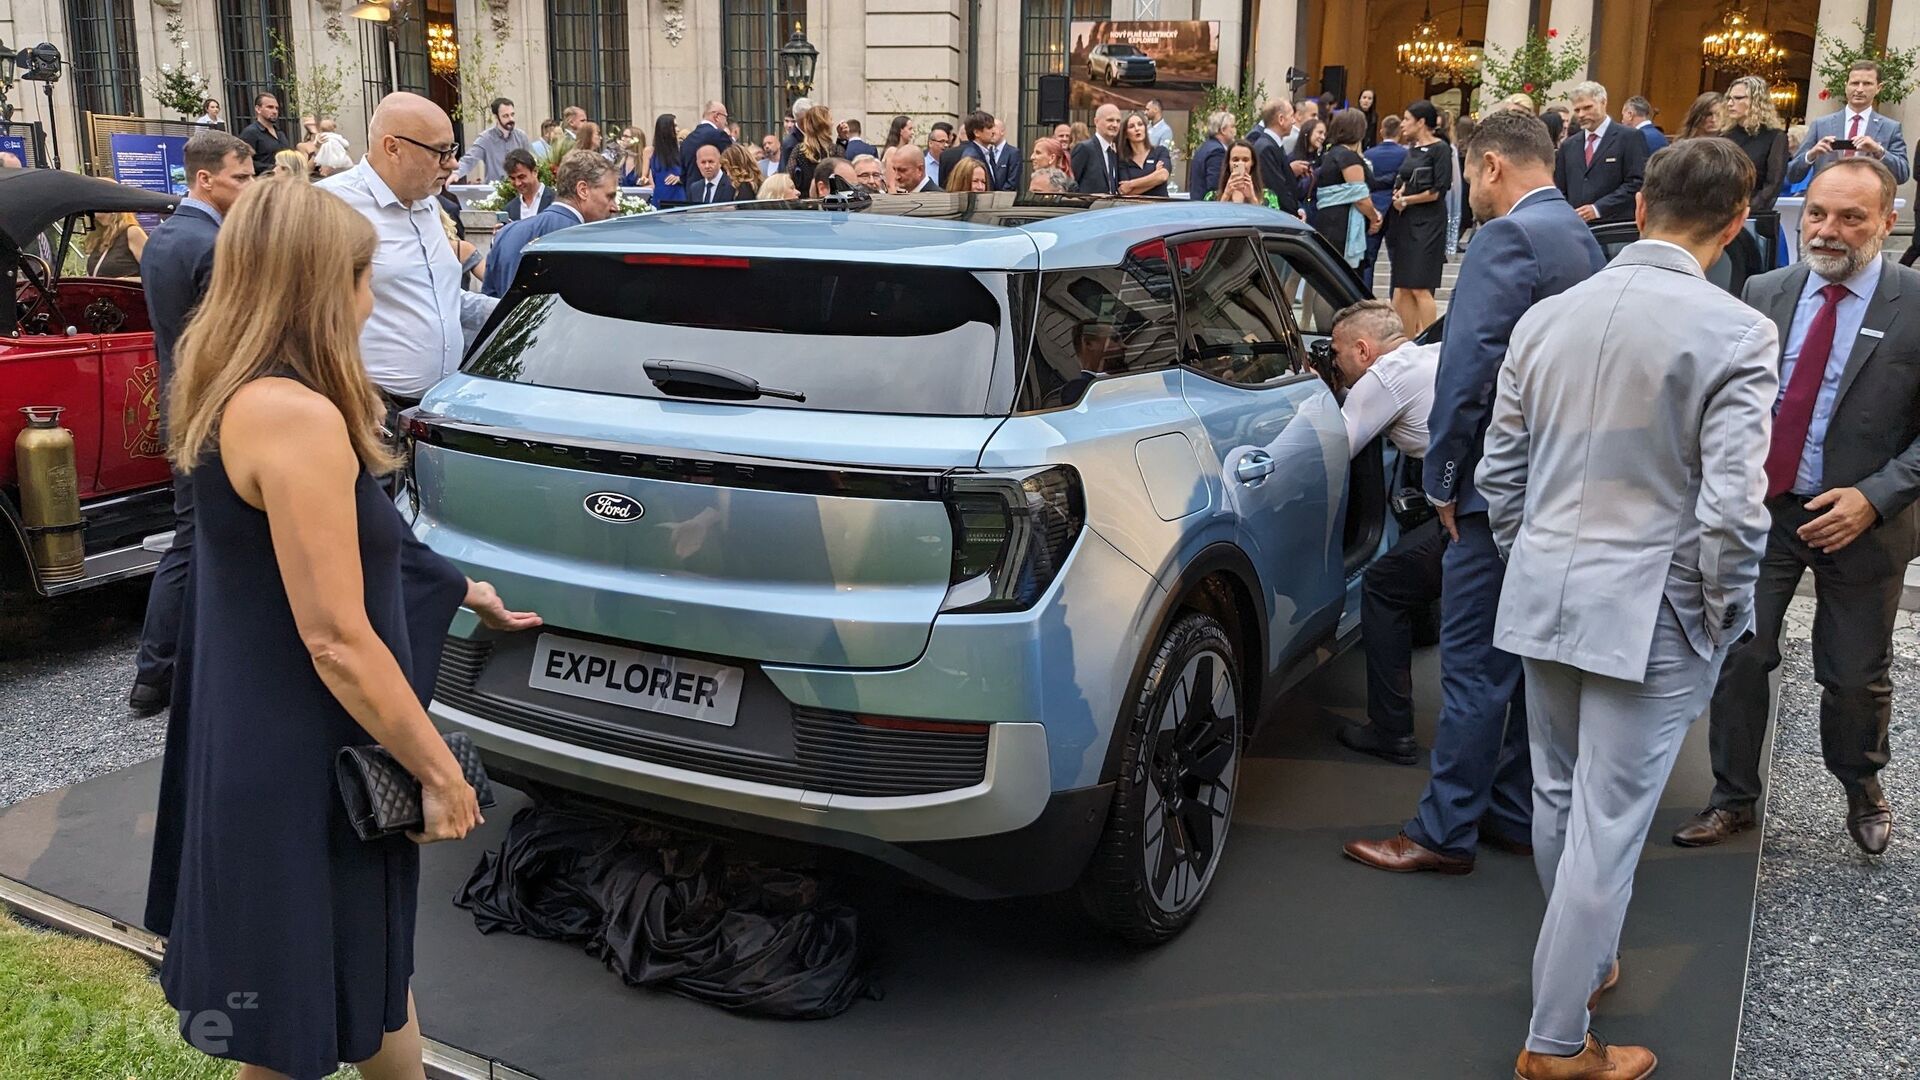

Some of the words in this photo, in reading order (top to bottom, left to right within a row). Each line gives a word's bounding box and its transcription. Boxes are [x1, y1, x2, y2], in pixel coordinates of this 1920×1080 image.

[142, 367, 157, 384] FI
[594, 495, 632, 518] Ford
[545, 649, 719, 708] EXPLORER
